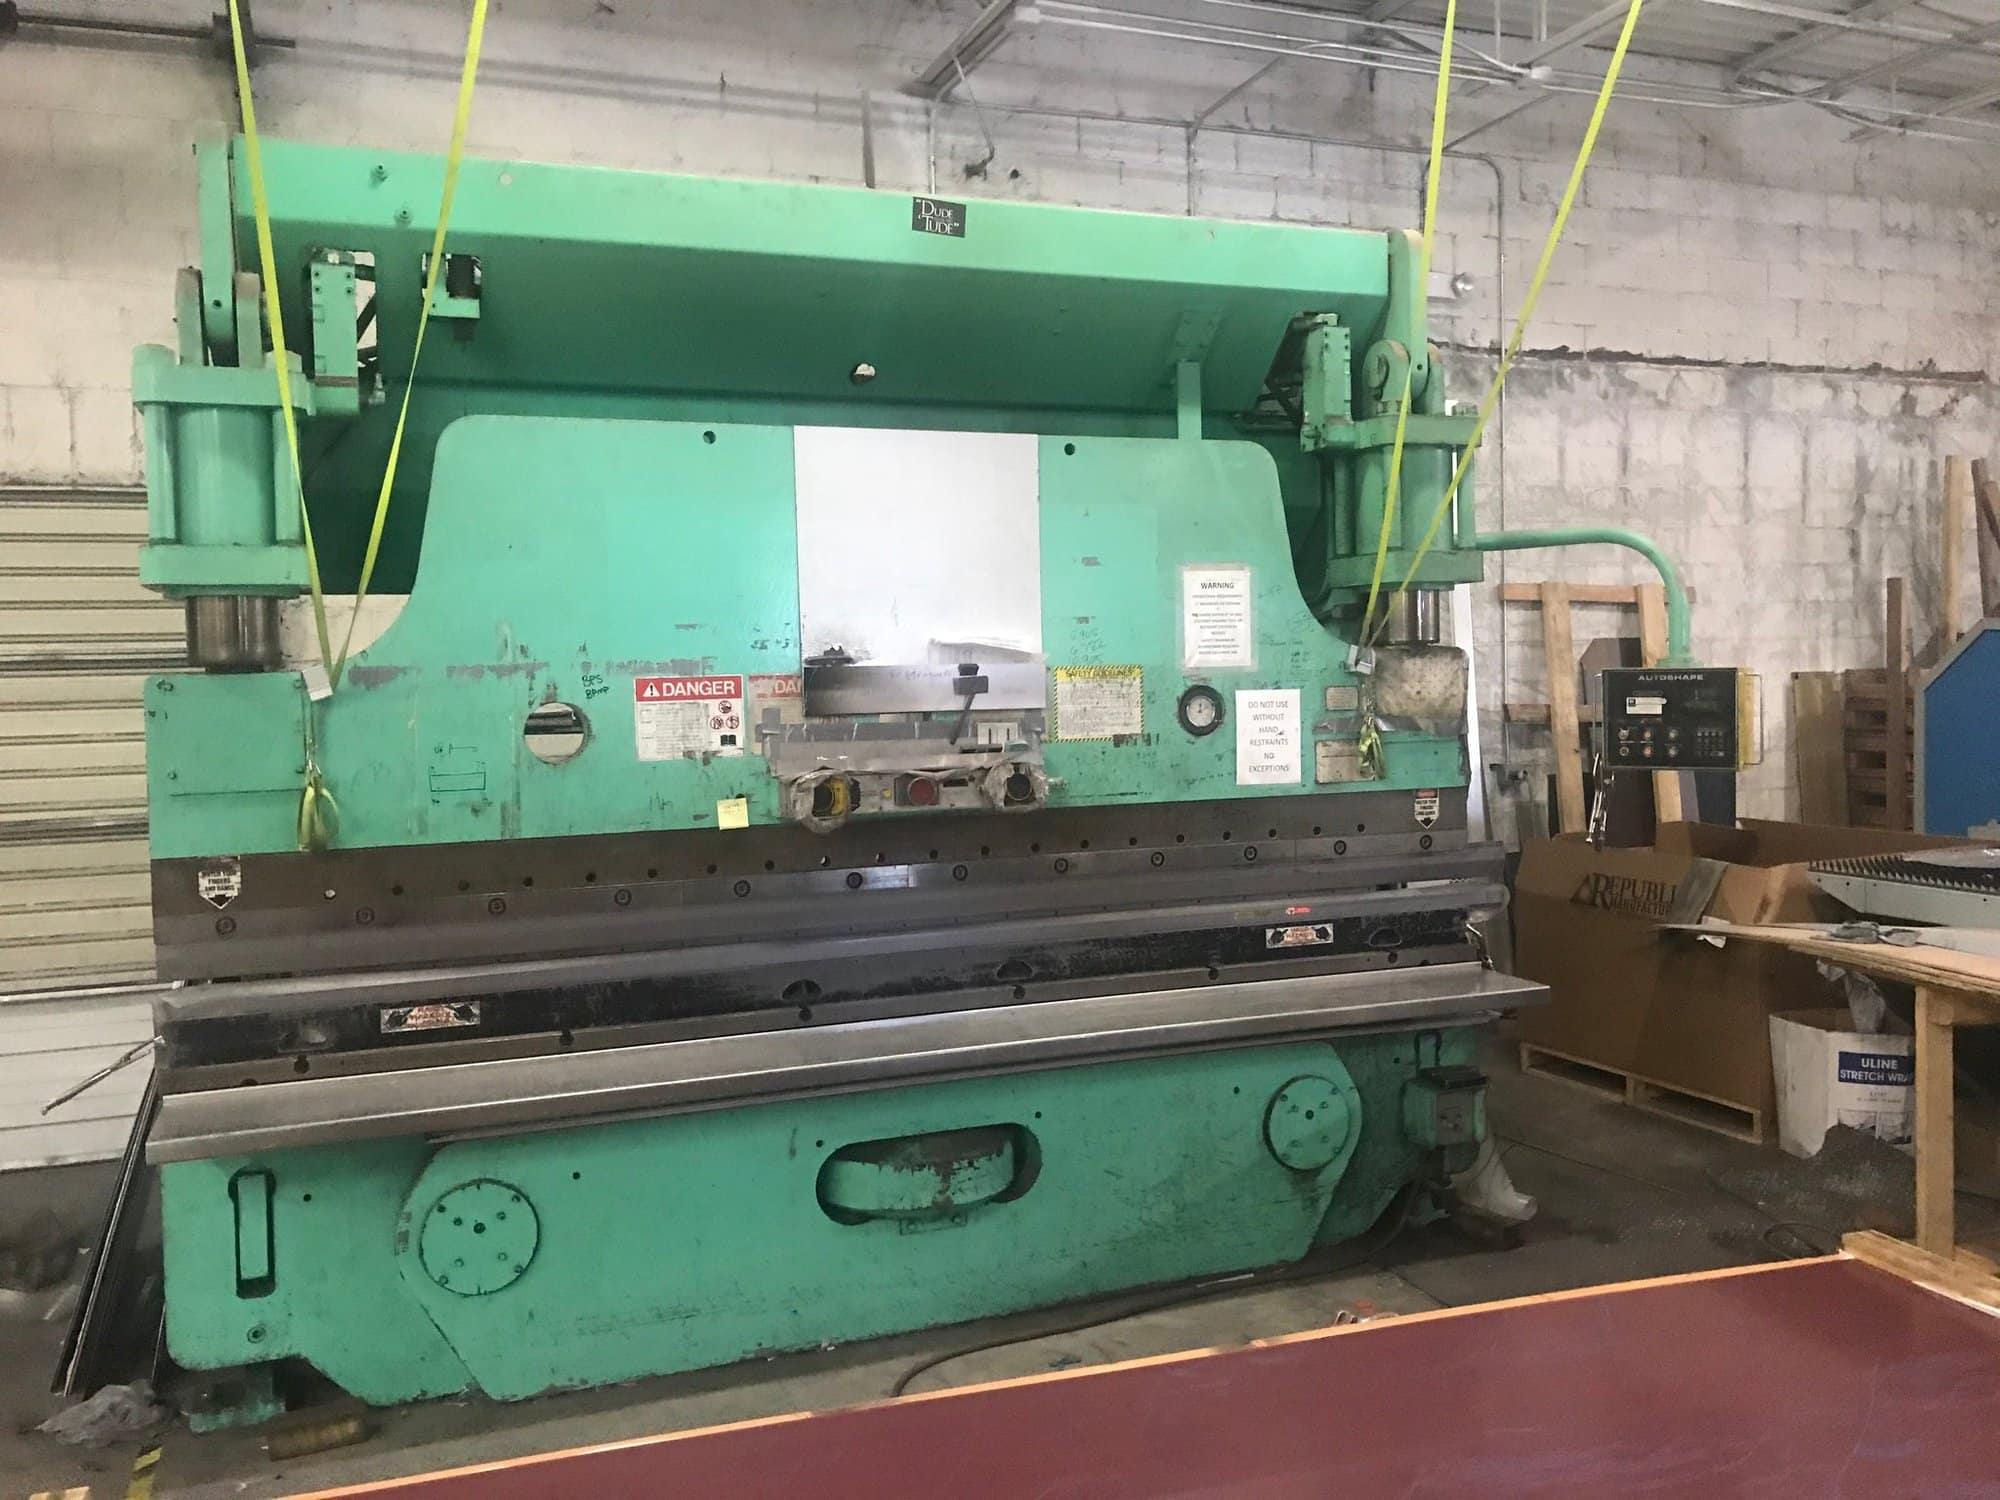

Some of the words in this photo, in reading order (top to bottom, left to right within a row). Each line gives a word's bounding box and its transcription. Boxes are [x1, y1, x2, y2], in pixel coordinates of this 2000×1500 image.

[1201, 582, 1234, 590] WARNING
[661, 681, 736, 697] DANGER
[1248, 701, 1258, 709] DO
[1260, 700, 1274, 708] NOT
[1275, 700, 1289, 708] USE
[1252, 713, 1285, 721] WITHOUT
[1259, 726, 1279, 734] HAND
[1249, 738, 1289, 746] RESTRAINTS
[1263, 752, 1275, 760] NO
[1248, 764, 1290, 773] EXCEPTIONS
[1592, 872, 1677, 911] REPUBLI
[1860, 1058, 1899, 1070] ULINE
[1839, 1069, 1885, 1081] STRETCH
